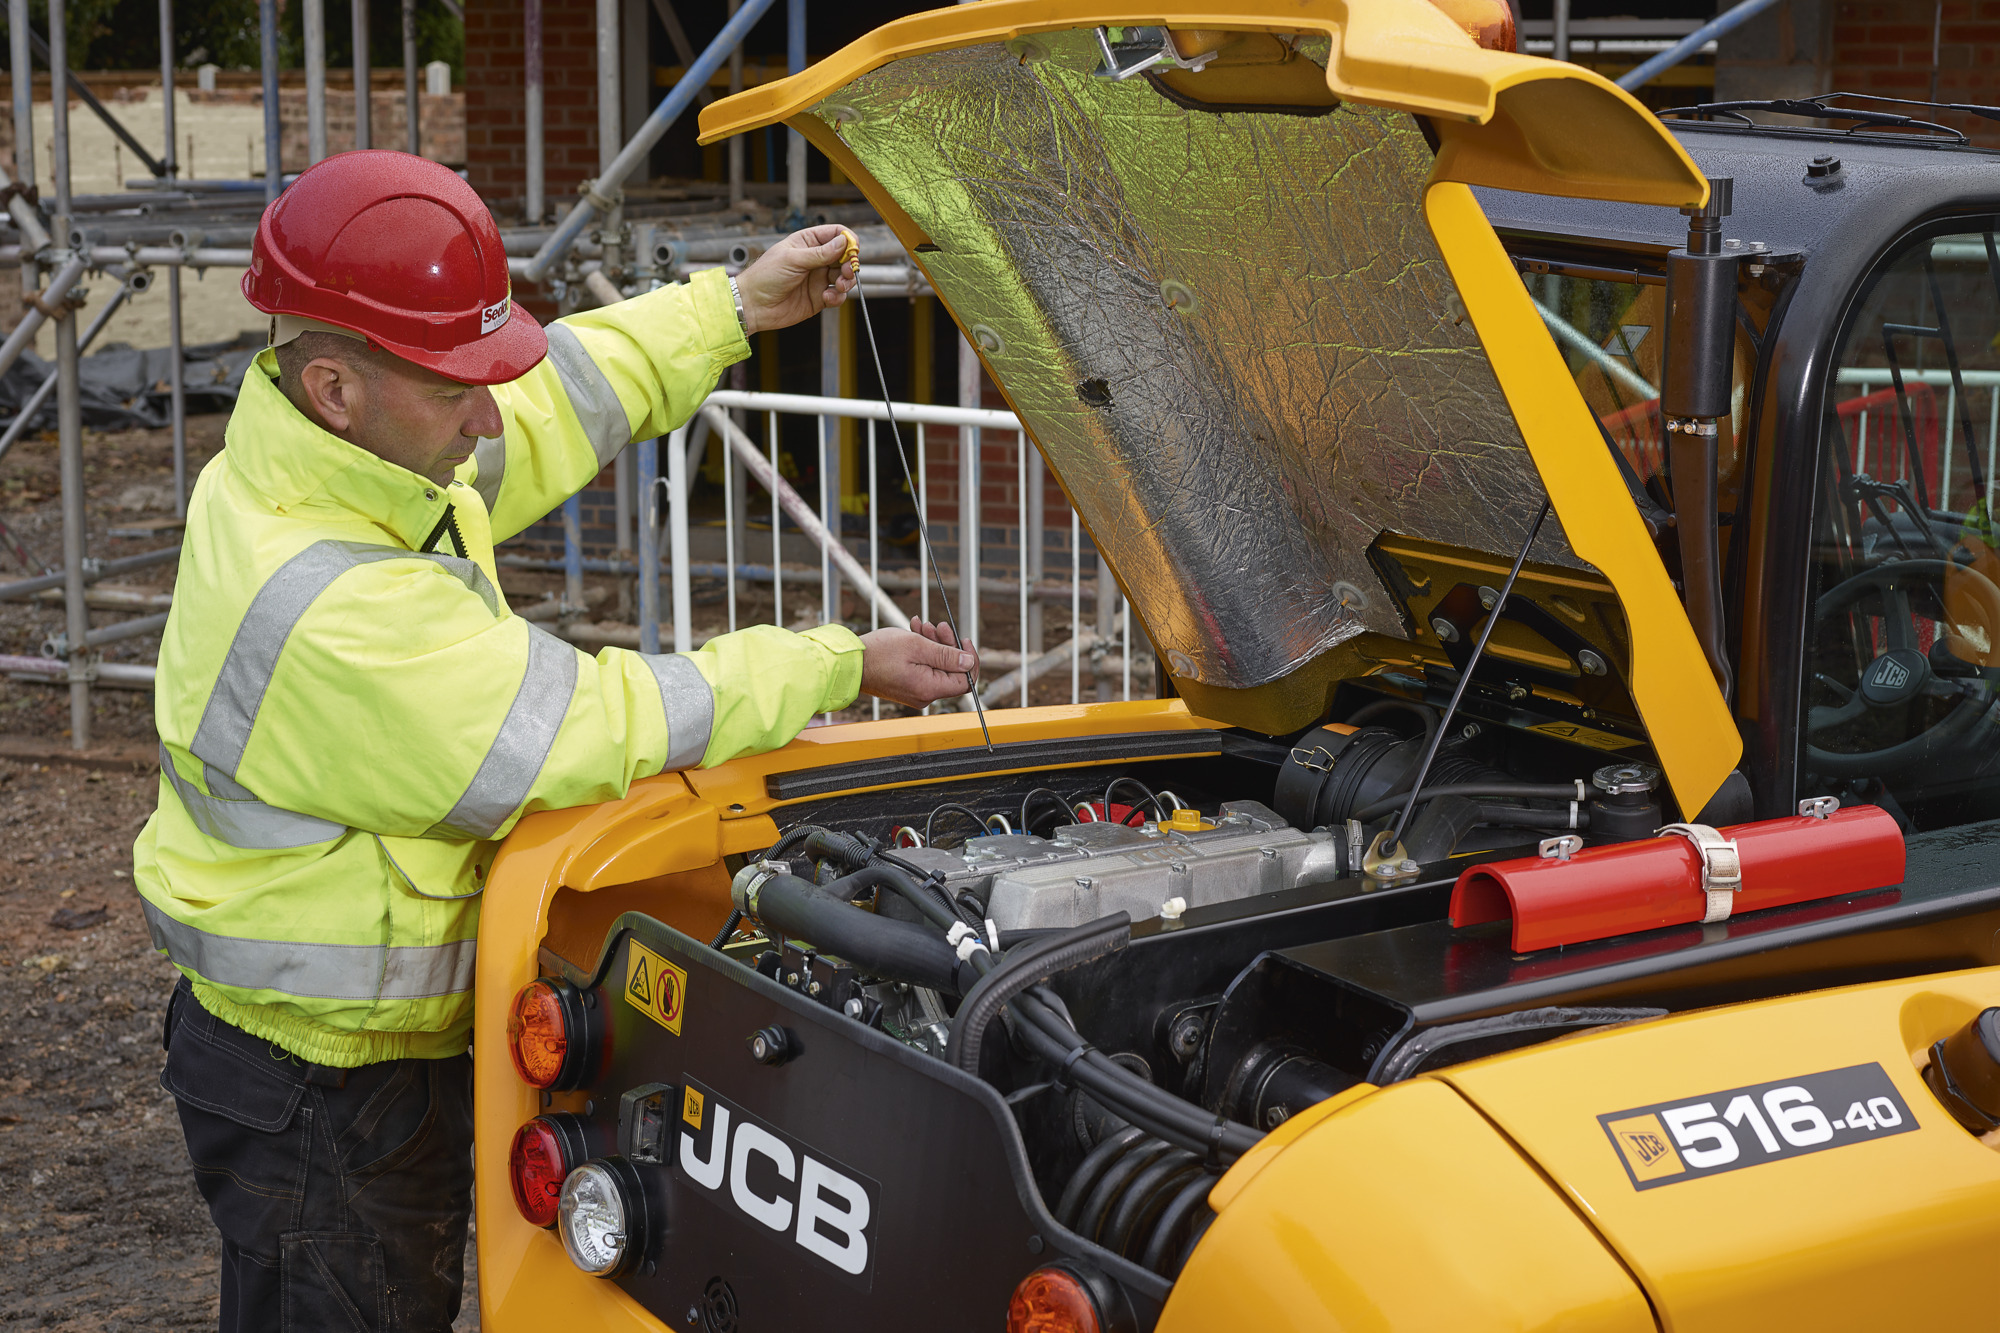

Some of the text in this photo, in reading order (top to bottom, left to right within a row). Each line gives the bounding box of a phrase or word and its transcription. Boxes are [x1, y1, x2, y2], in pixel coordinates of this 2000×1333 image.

[1874, 660, 1907, 686] JCB
[1630, 1086, 1903, 1168] JCB 516-40
[680, 1103, 870, 1275] JCB
